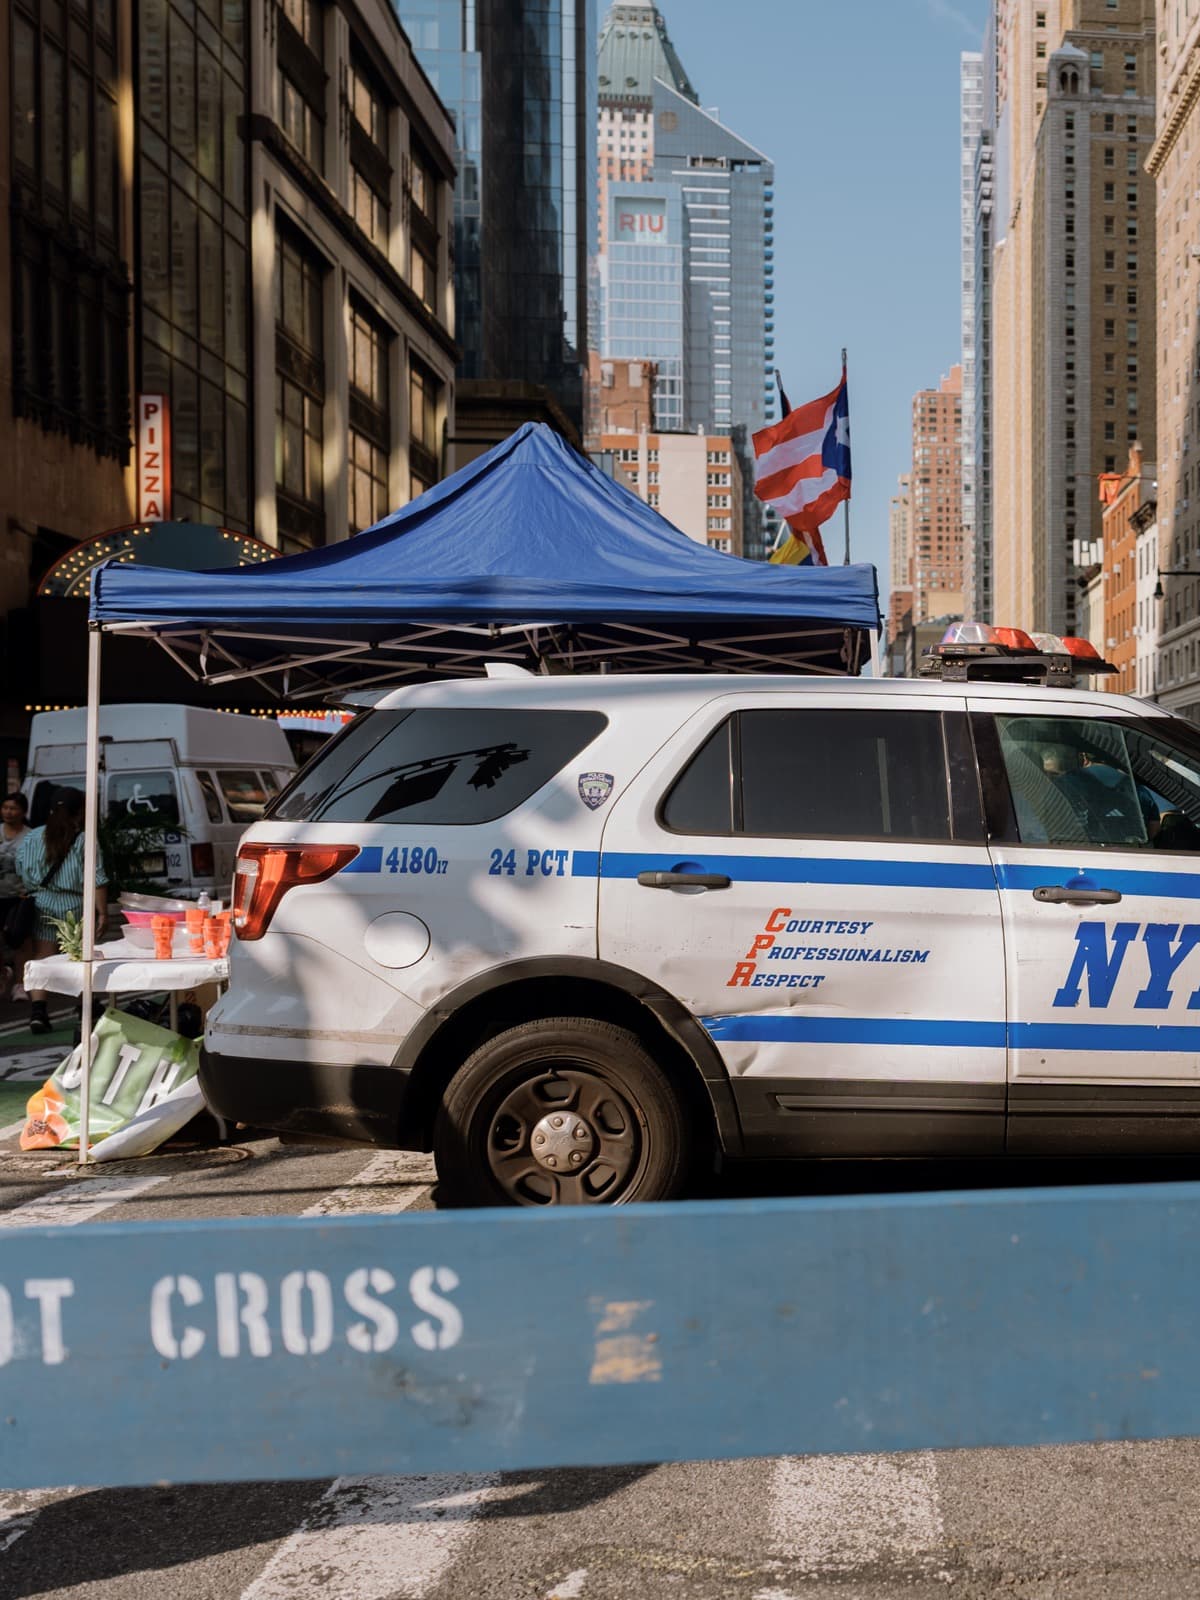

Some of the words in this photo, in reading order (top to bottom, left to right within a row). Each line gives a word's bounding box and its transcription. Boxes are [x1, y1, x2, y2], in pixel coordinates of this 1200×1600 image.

[618, 213, 664, 233] RIU
[144, 402, 161, 518] PIZZA
[386, 846, 438, 874] 4180
[488, 848, 517, 876] 24
[526, 850, 569, 876] PCT
[0, 1278, 74, 1367] T
[150, 1265, 464, 1360] CROSS
